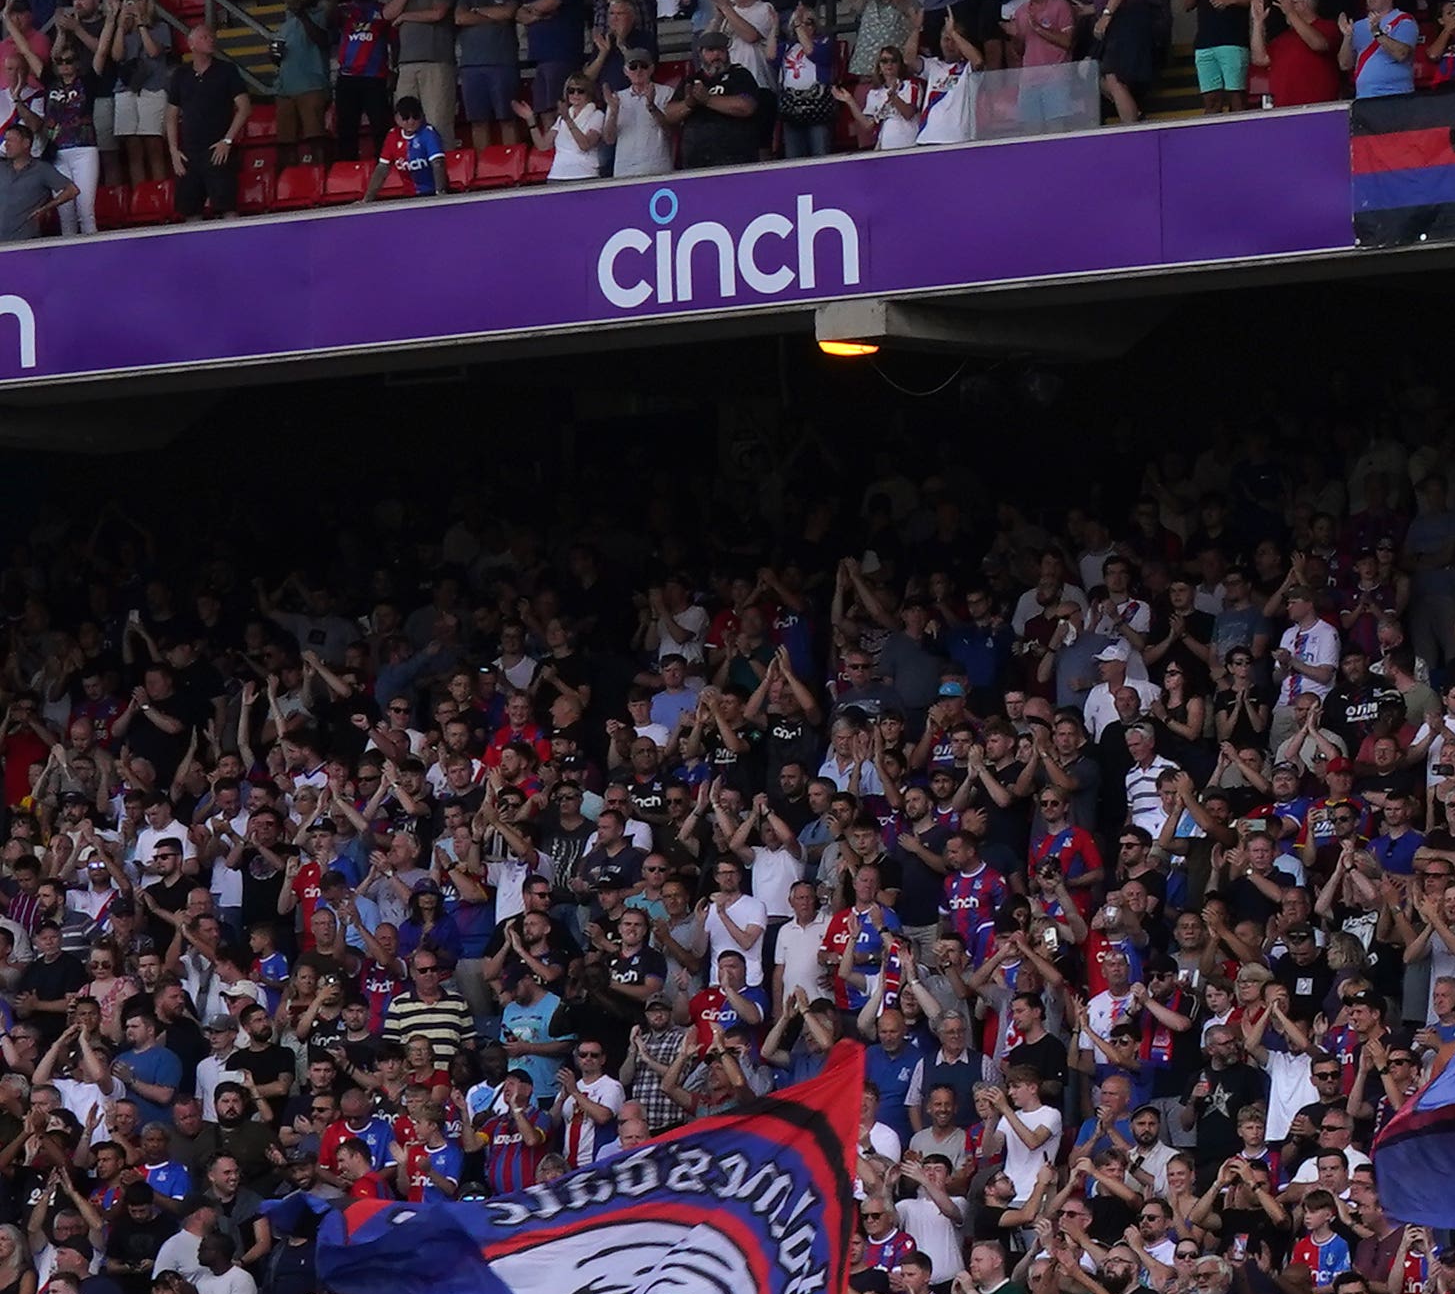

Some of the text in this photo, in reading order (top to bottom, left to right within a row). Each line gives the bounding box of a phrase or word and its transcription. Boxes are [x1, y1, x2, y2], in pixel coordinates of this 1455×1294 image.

[396, 157, 428, 171] cinch
[598, 188, 860, 308] cinch
[304, 886, 320, 899] cin
[949, 897, 979, 909] cinch
[366, 977, 394, 992] cinch
[701, 1008, 737, 1023] cinch
